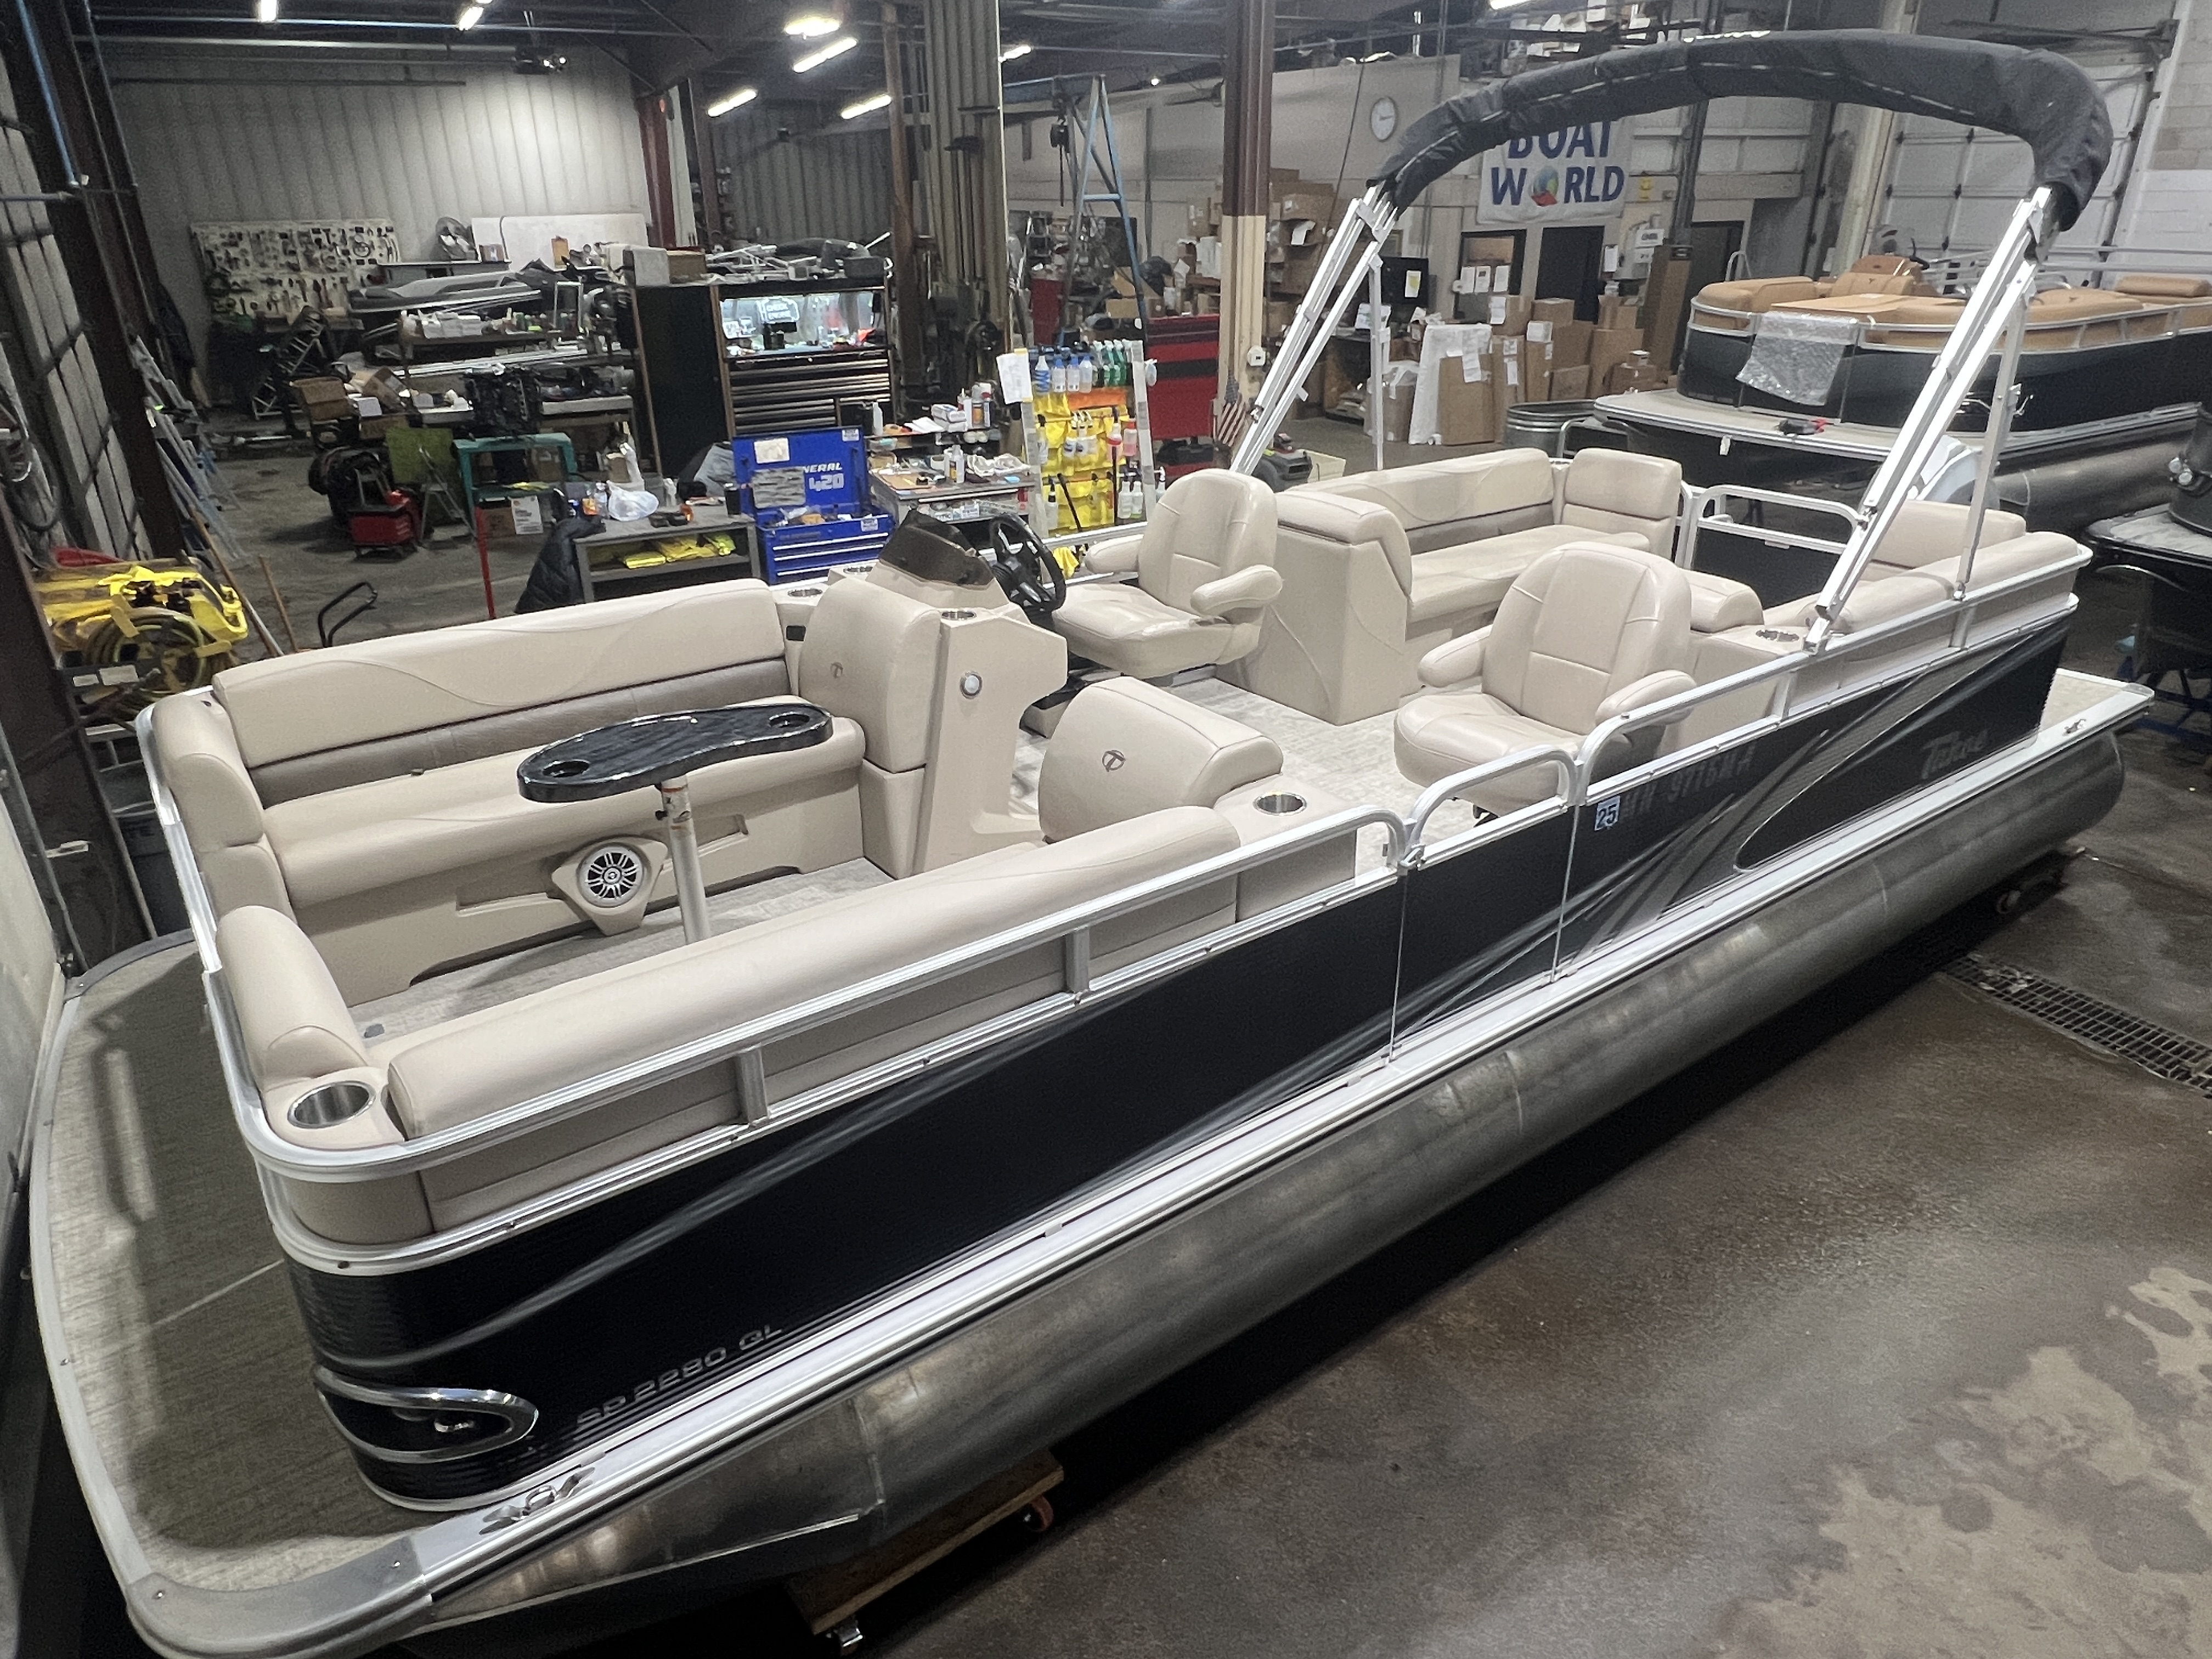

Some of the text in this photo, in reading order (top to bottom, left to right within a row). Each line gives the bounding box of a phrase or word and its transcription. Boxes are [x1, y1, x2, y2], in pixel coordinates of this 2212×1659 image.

[1509, 121, 1611, 159] BOAT
[809, 473, 844, 491] 420
[1596, 803, 1617, 829] 25
[634, 1346, 727, 1402] 2280
